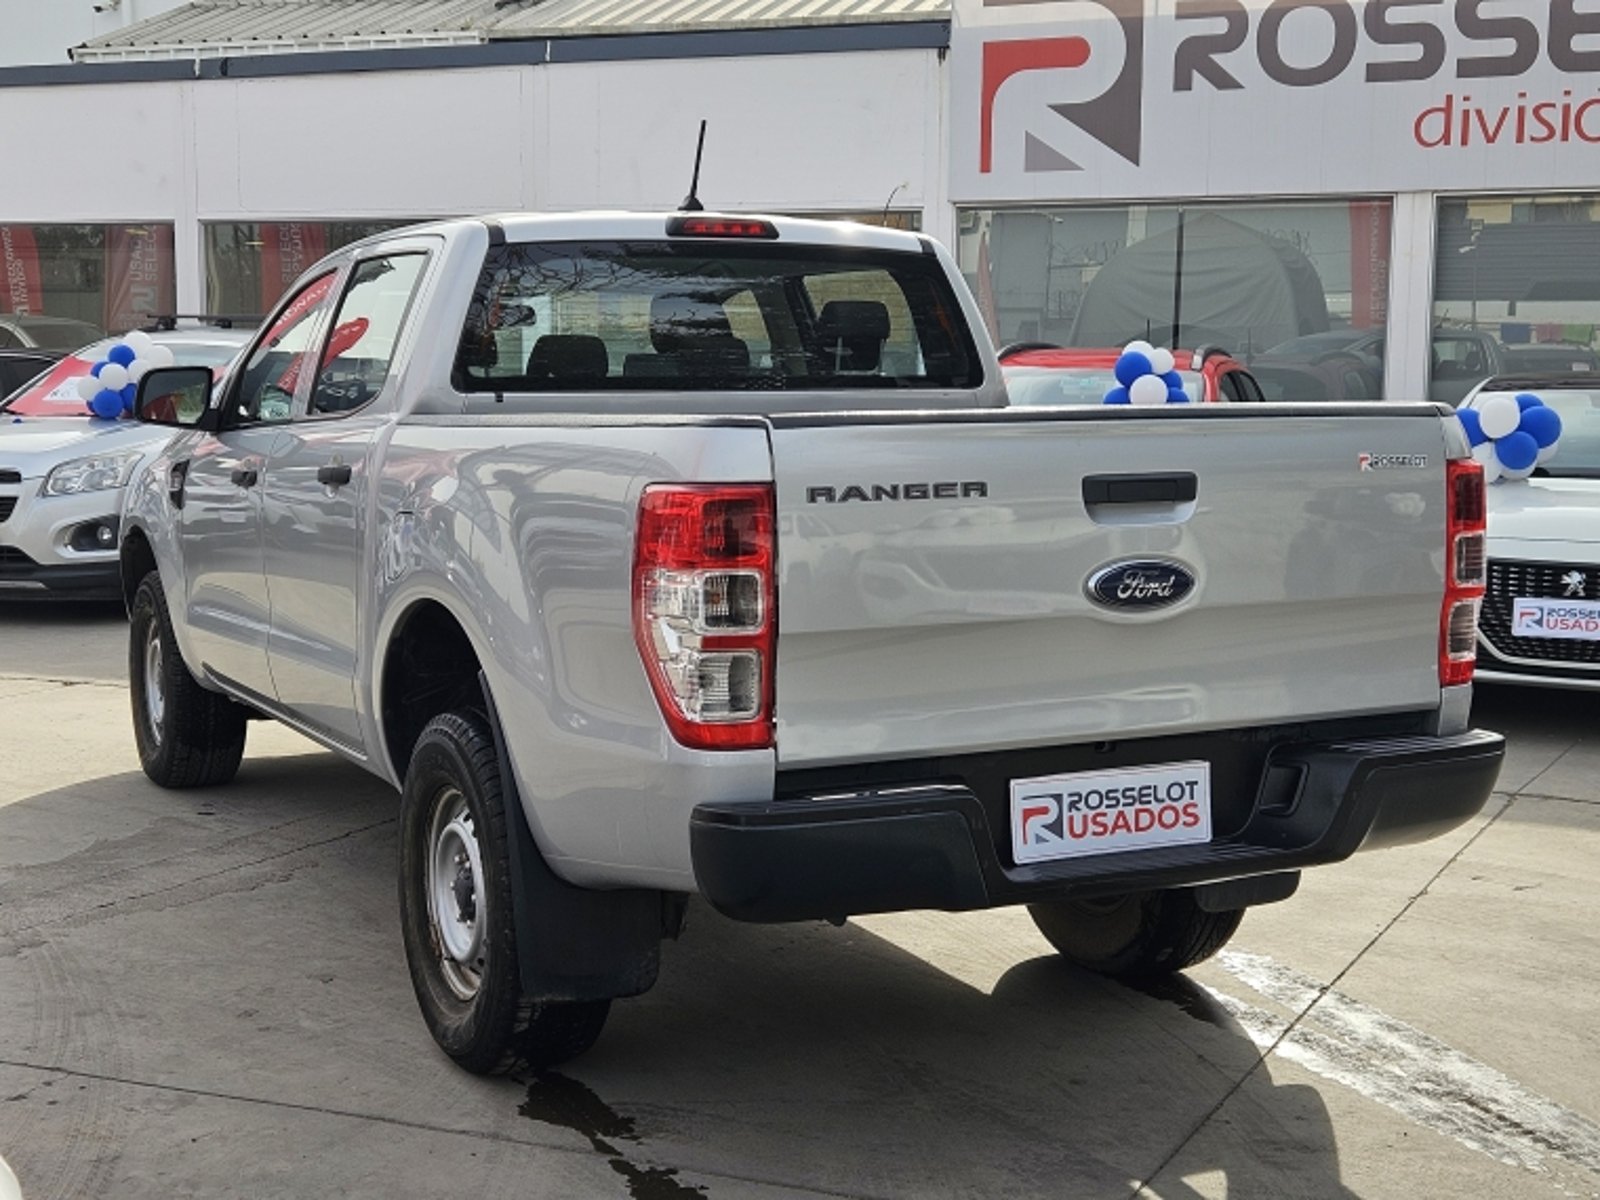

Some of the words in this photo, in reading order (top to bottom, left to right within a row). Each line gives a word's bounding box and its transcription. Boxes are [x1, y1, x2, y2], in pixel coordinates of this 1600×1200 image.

[806, 481, 988, 504] RANGER
[1117, 569, 1176, 599] Ford
[1067, 780, 1199, 813] ROSSELOT
[1067, 802, 1201, 840] USADOS
